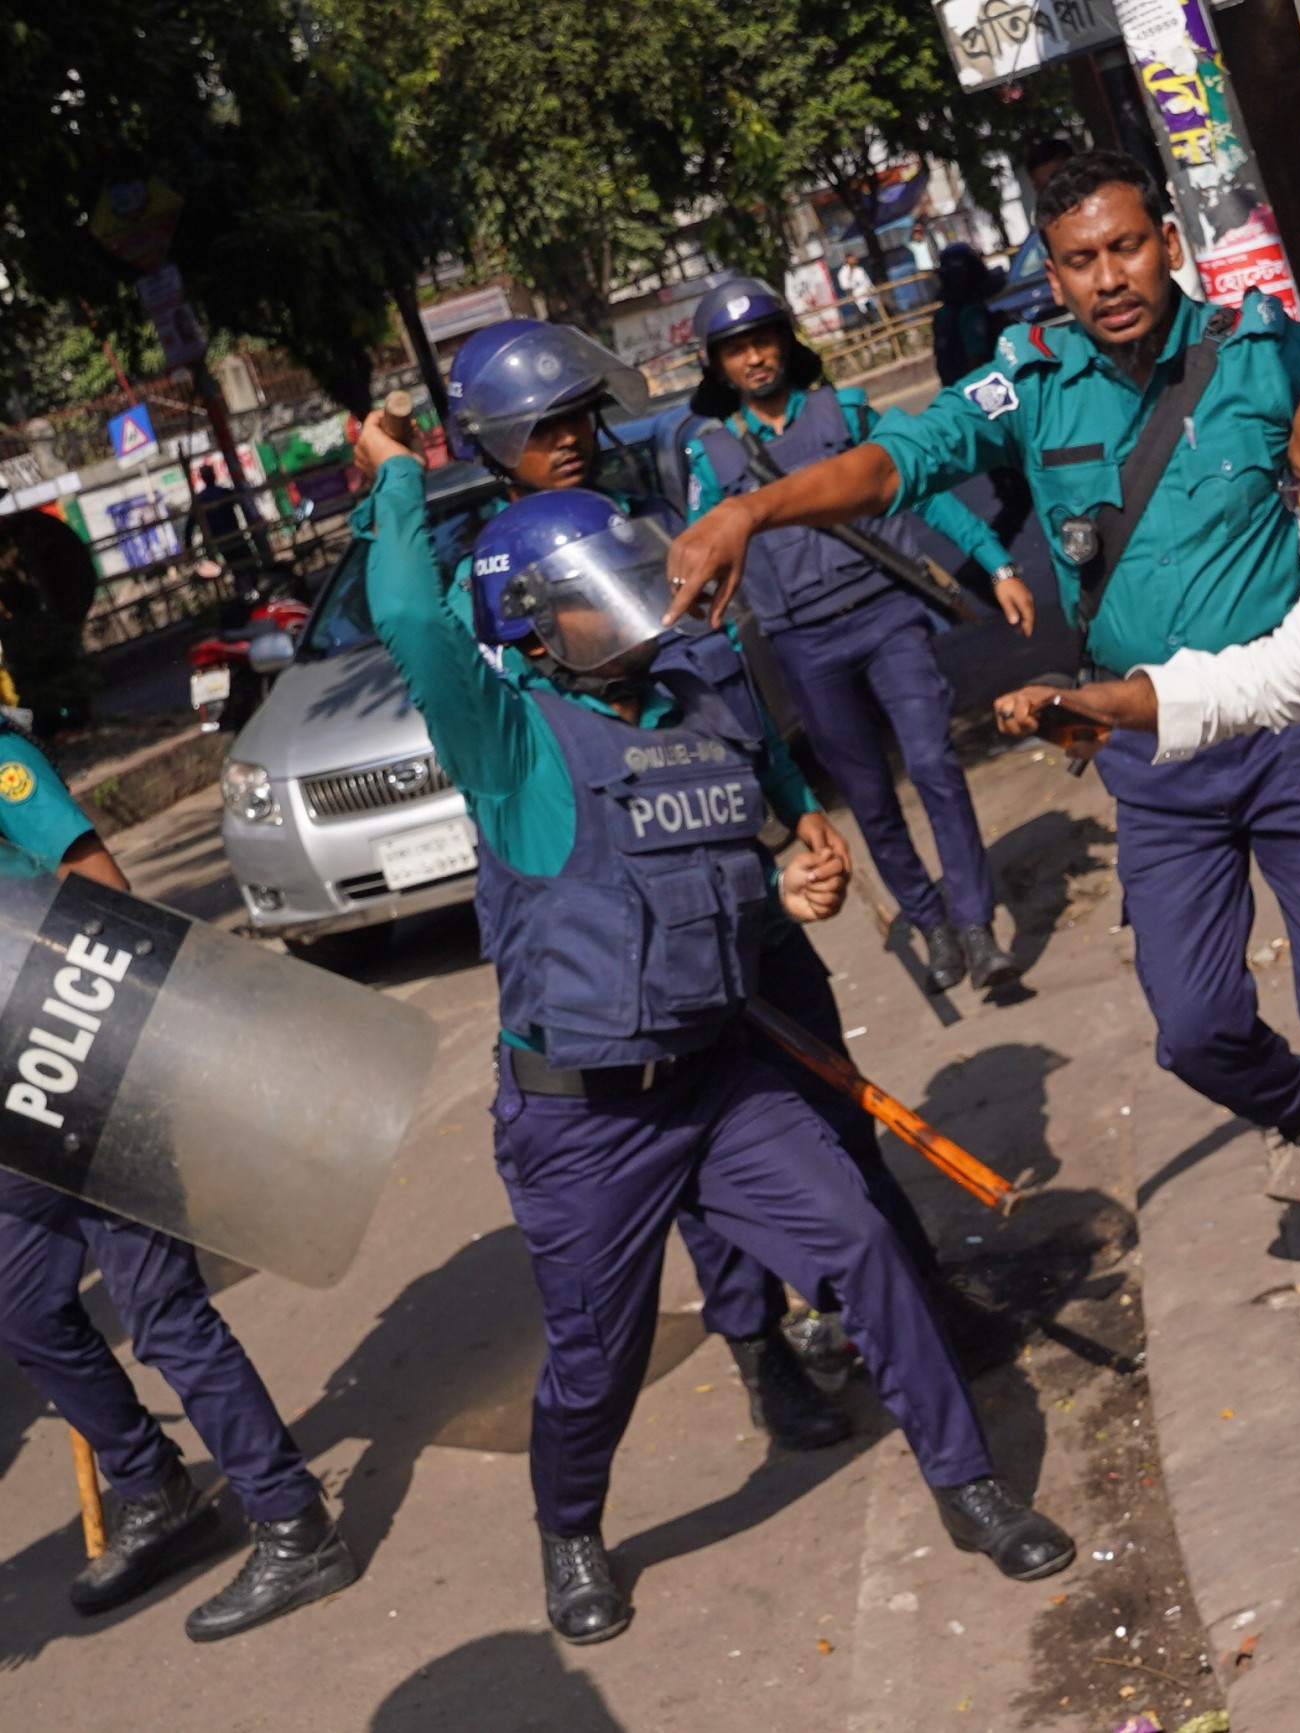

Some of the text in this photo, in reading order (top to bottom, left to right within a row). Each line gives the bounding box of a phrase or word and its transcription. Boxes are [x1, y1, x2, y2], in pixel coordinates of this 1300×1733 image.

[474, 553, 511, 577] OLICE
[629, 782, 748, 838] POLICE
[5, 933, 133, 1129] POLICE
